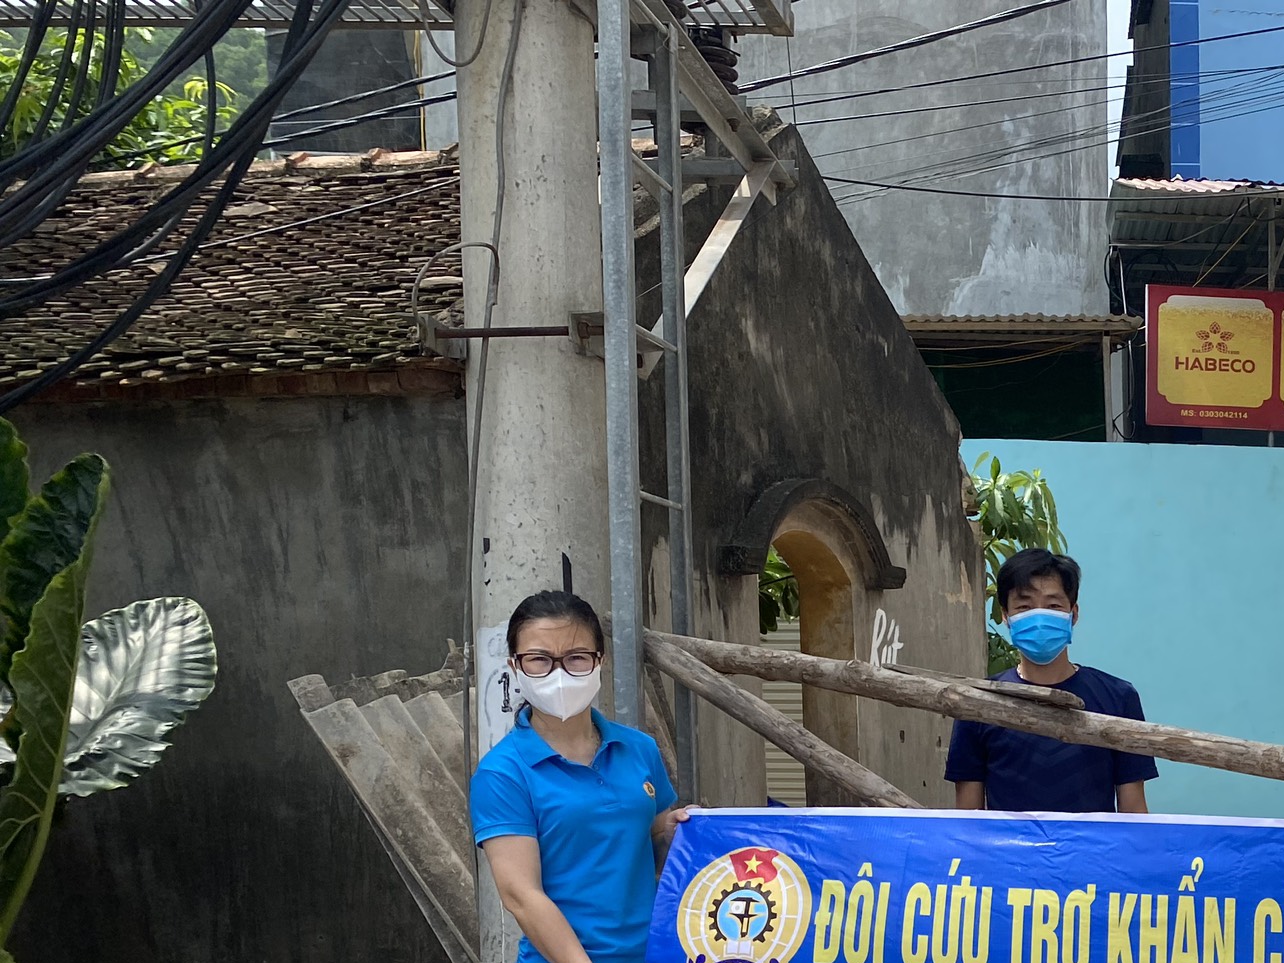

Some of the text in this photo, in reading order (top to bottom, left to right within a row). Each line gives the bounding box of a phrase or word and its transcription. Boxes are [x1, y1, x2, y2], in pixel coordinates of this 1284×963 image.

[1174, 356, 1256, 374] HABECO
[1180, 409, 1248, 419] MS: 0303042114
